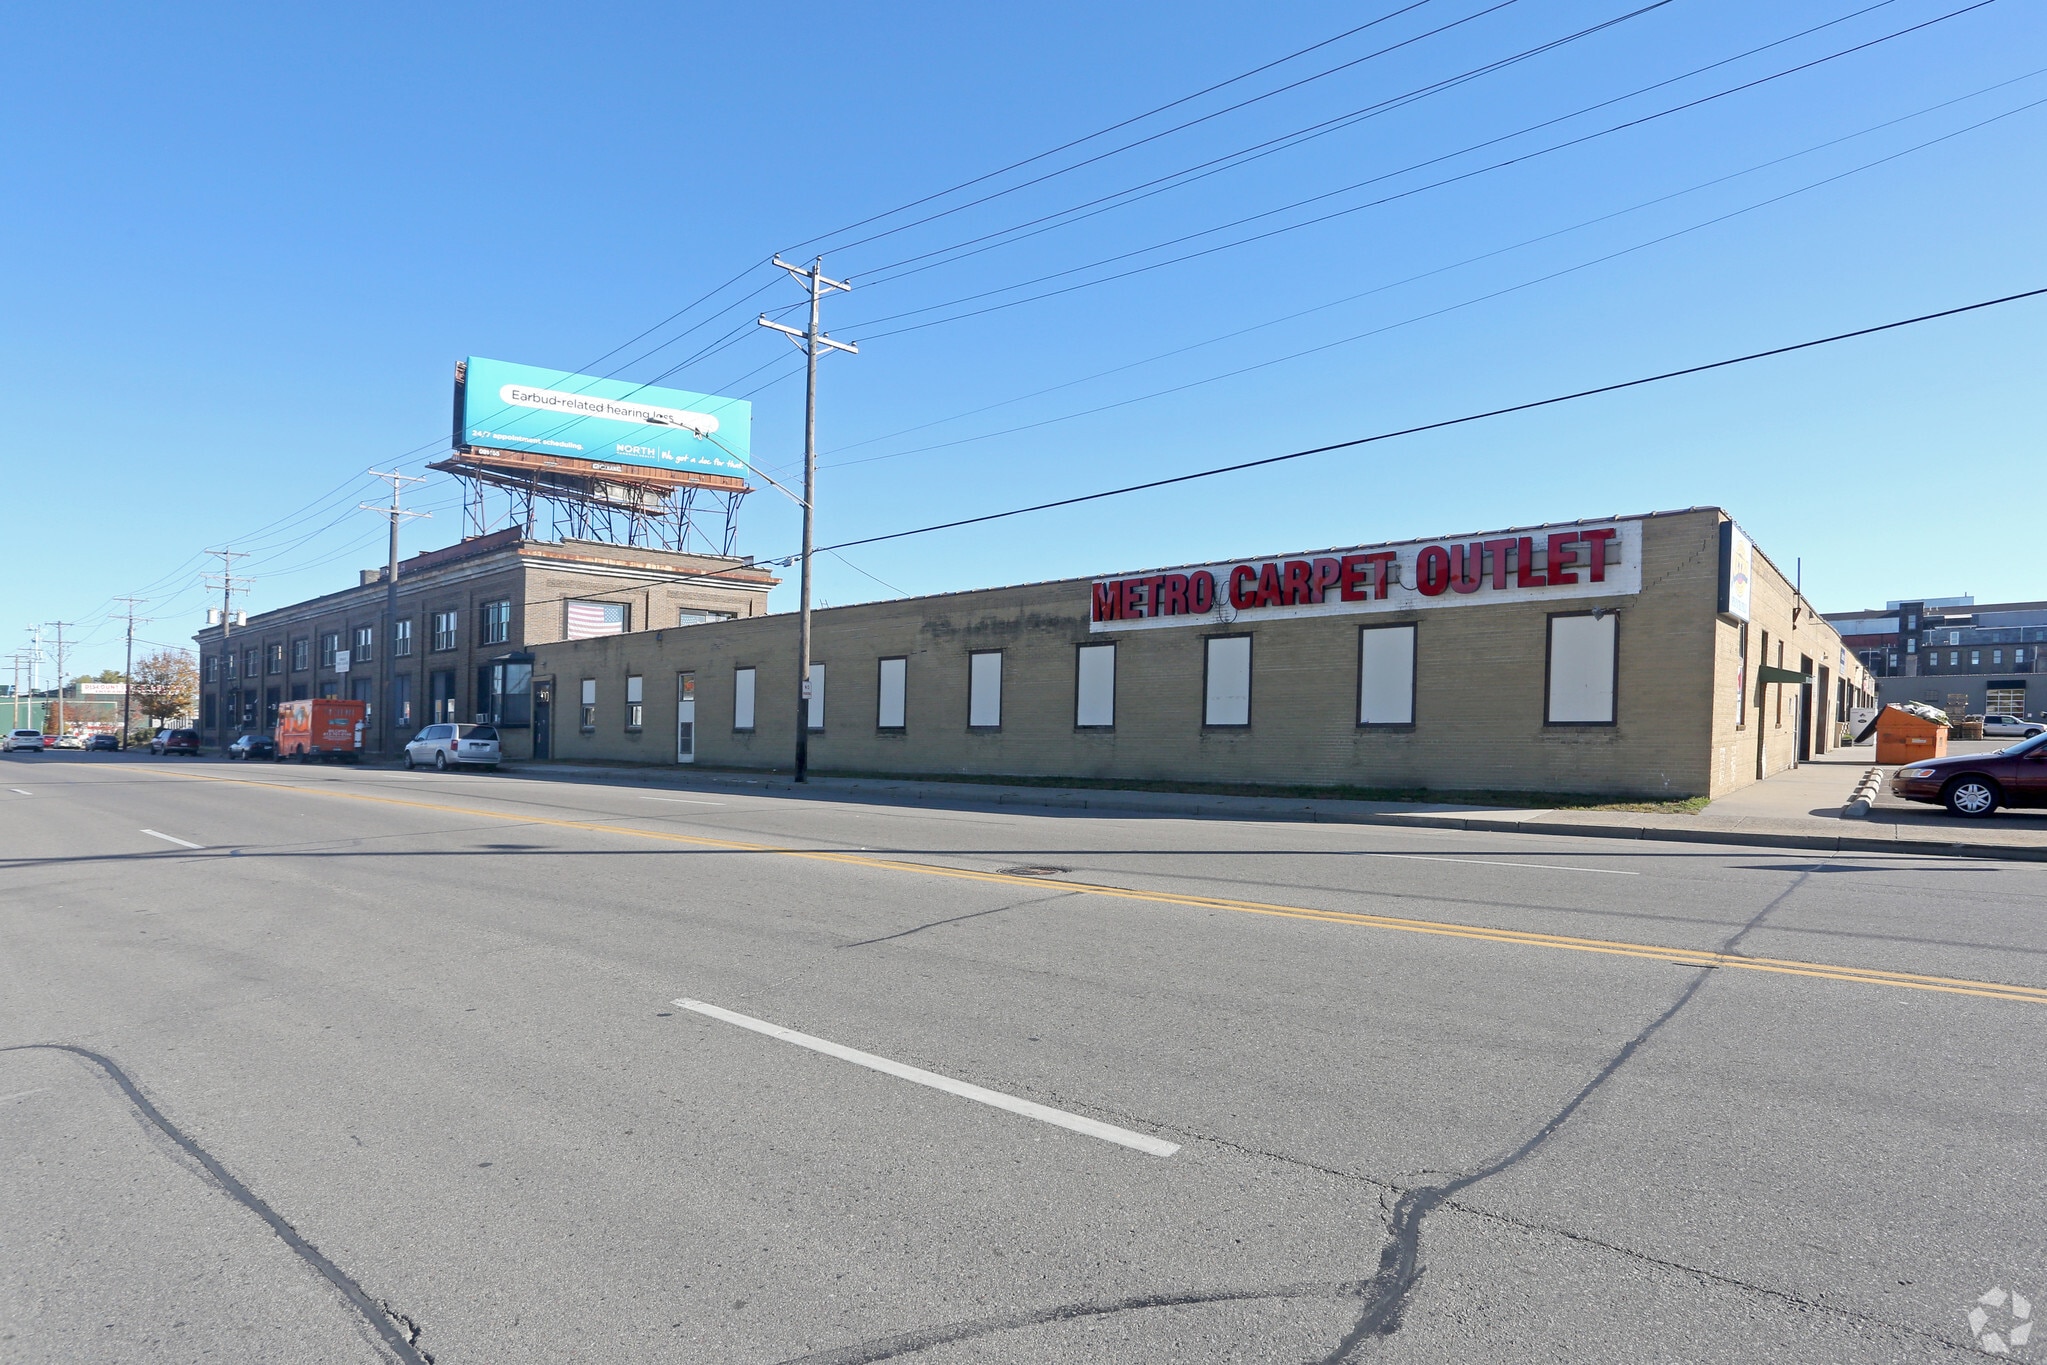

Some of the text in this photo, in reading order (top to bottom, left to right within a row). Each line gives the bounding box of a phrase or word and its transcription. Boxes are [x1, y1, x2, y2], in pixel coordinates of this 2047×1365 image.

[512, 389, 604, 412] Earbud-related
[607, 405, 650, 420] hearing
[472, 430, 584, 450] 24/7 appointment scheduling.
[616, 443, 656, 456] NORTH
[661, 450, 674, 460] We
[675, 454, 689, 464] got
[698, 456, 712, 465] doc
[713, 458, 725, 467] for
[1093, 528, 1617, 622] METRO CARPET OUTLET
